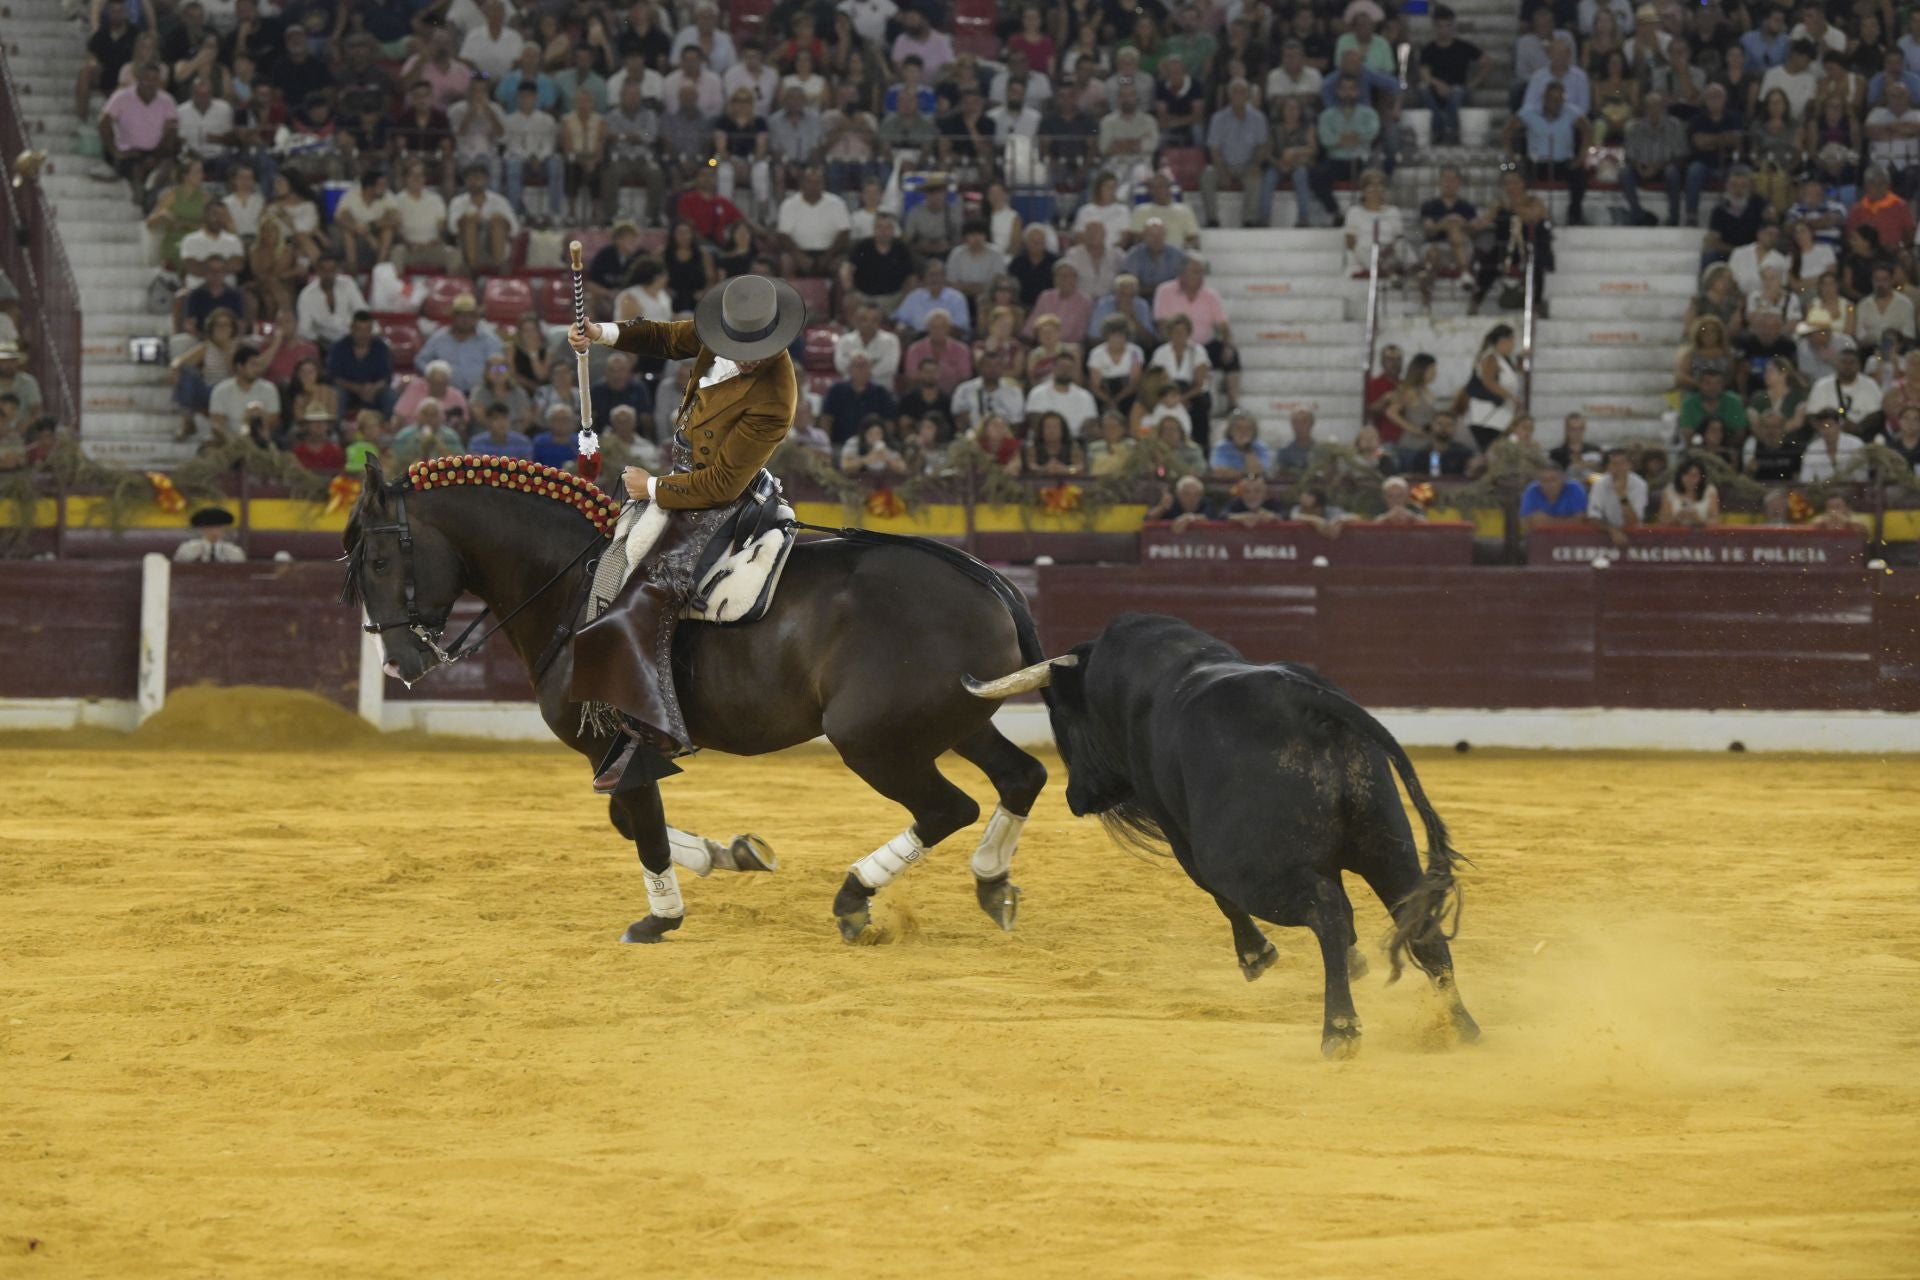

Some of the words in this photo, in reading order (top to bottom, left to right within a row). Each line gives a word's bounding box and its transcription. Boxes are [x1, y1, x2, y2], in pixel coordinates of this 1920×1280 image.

[1627, 546, 1715, 562] NACIONAL
[1721, 546, 1745, 562] DE
[1753, 547, 1826, 562] POLICIA
